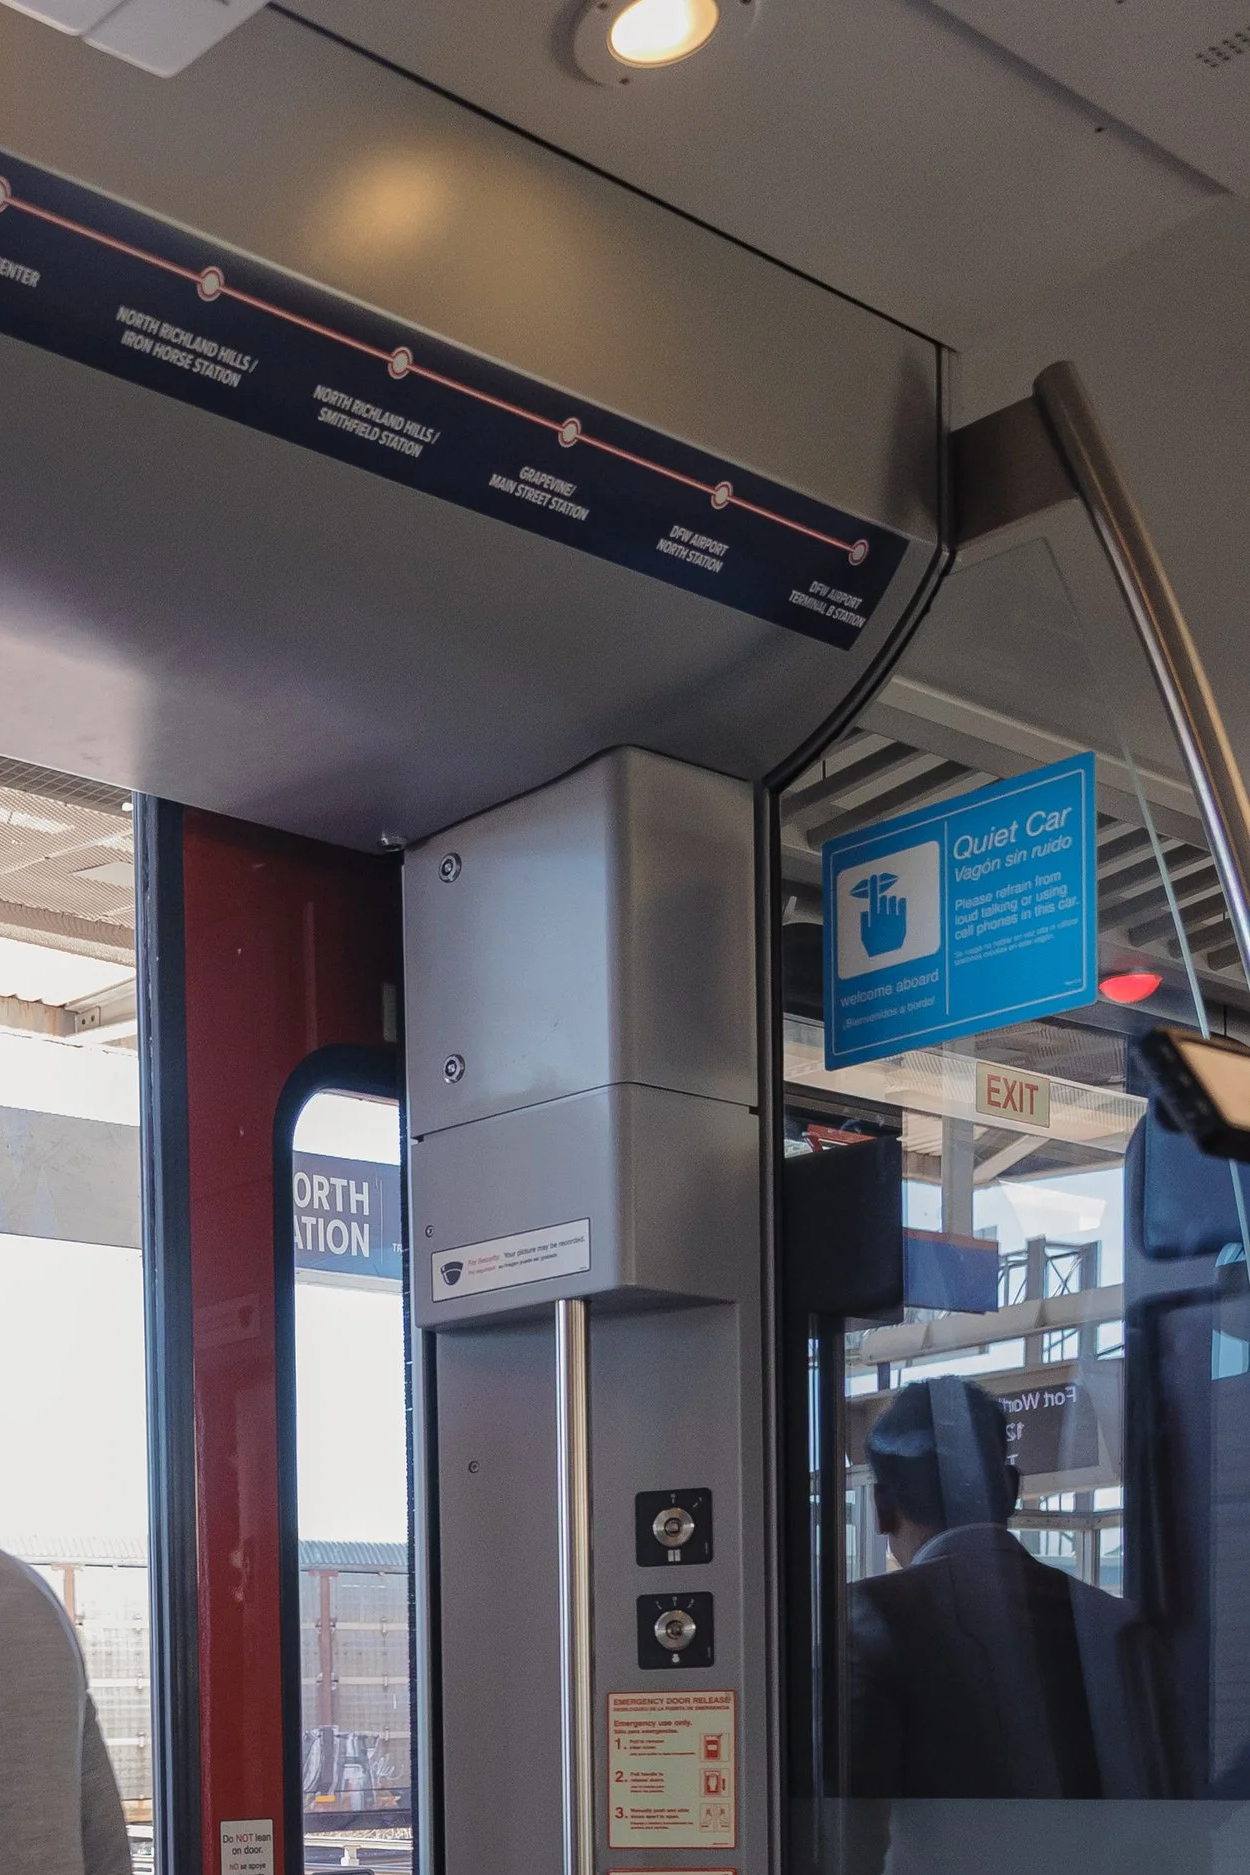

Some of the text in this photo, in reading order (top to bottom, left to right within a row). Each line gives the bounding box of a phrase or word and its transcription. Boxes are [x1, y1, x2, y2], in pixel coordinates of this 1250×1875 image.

[115, 304, 162, 335] NORTH
[157, 322, 219, 358] RICHLAND
[216, 345, 252, 372] HILLS
[120, 329, 243, 388] IRON HORSE STATION
[312, 384, 354, 411] NORTH
[350, 399, 406, 431] RICHLAND
[403, 420, 434, 443] HILLS
[317, 407, 424, 458] SMITHFIELD STATION
[488, 473, 590, 521] MAIN STREET STATION
[656, 538, 724, 573] NORTH STATION
[669, 525, 730, 557] DFW AIRPORT
[788, 589, 827, 614] TERMINAL
[832, 608, 867, 628] STATION
[808, 580, 863, 609] DFW AIRPORT
[953, 807, 1072, 860] Quiet Car
[954, 835, 1072, 882] Vagón sin ruido
[954, 871, 1062, 911] Please refrain from
[954, 884, 1068, 926] loud talking or using
[954, 925, 974, 941] cell
[976, 913, 1018, 936] phones
[1020, 909, 1031, 921] in
[1034, 902, 1055, 917] this
[839, 968, 939, 1007] welcome aboard
[987, 1074, 1039, 1115] EXIT
[693, 1696, 731, 1704] RELEASE
[613, 1720, 656, 1728] Emergency
[222, 1833, 271, 1843] Do NOT lean
[231, 1845, 263, 1855] on door.
